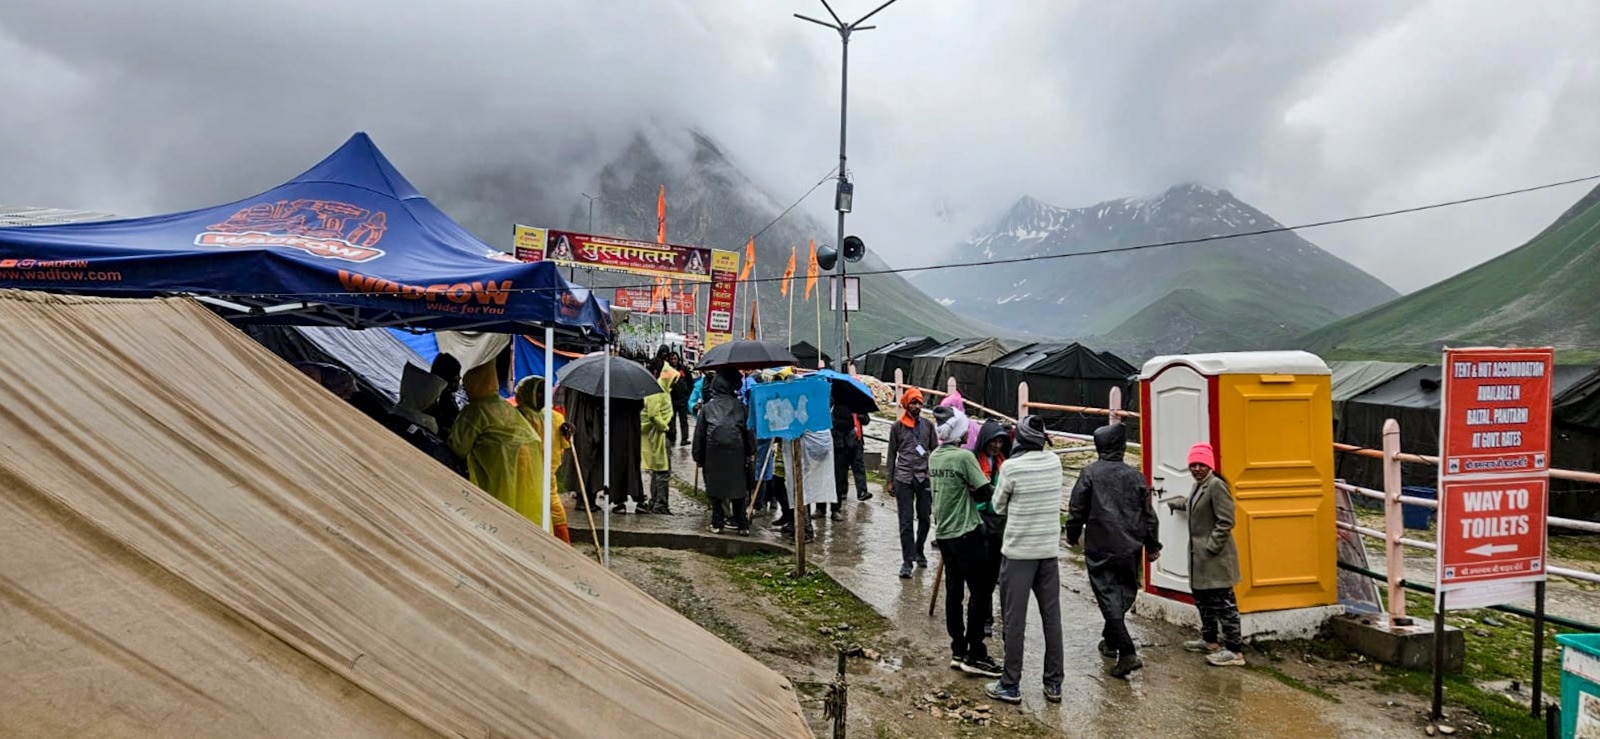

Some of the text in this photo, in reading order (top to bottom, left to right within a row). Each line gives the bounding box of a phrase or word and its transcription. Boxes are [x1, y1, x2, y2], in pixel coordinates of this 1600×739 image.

[214, 235, 363, 258] WADFOW
[38, 260, 88, 268] WADFOW
[337, 269, 513, 305] WADFOW
[426, 302, 505, 315] Wide for You
[1454, 362, 1471, 377] TENT
[1472, 364, 1477, 377] &
[1478, 362, 1492, 377] HUT
[1477, 385, 1520, 401] AVAILABLE IN
[1472, 433, 1481, 448] AT
[1501, 431, 1521, 446] RATES
[1462, 489, 1529, 513] WAY TO
[1460, 515, 1529, 539] TOILETS
